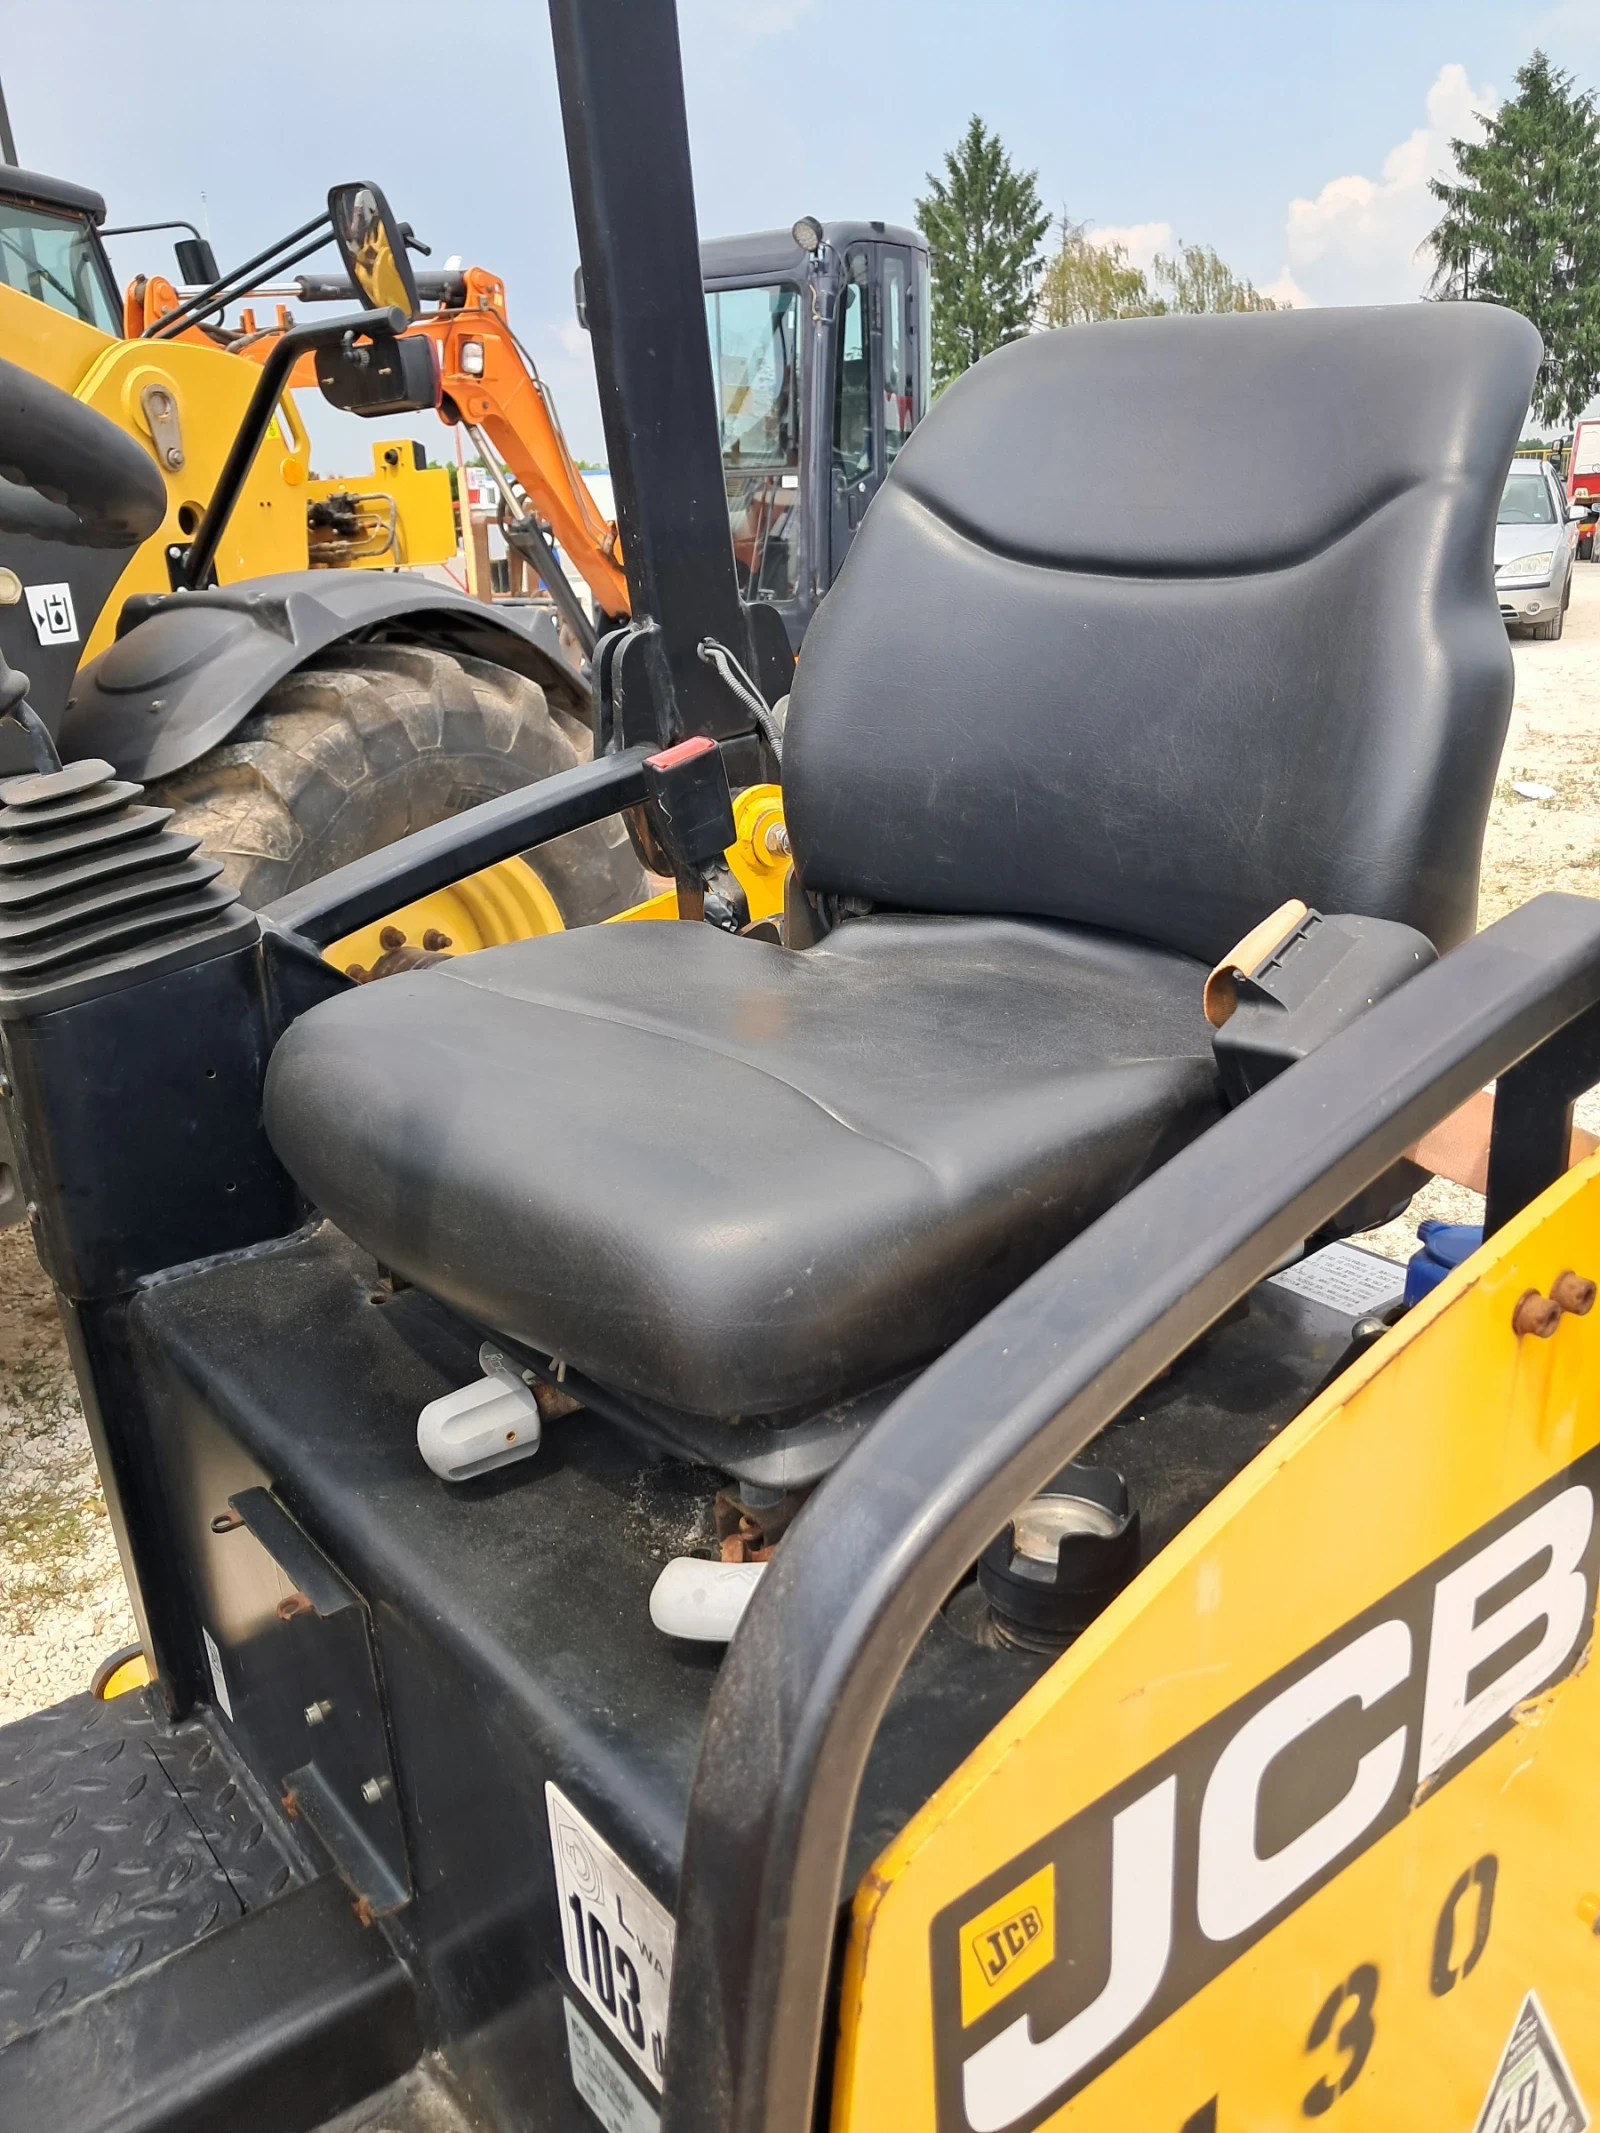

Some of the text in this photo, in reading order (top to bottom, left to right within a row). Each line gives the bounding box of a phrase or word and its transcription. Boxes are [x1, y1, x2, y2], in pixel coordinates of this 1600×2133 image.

[963, 1485, 1594, 2133] JCB
[568, 1891, 645, 2051] 103
[986, 1912, 1040, 1976] JCB
